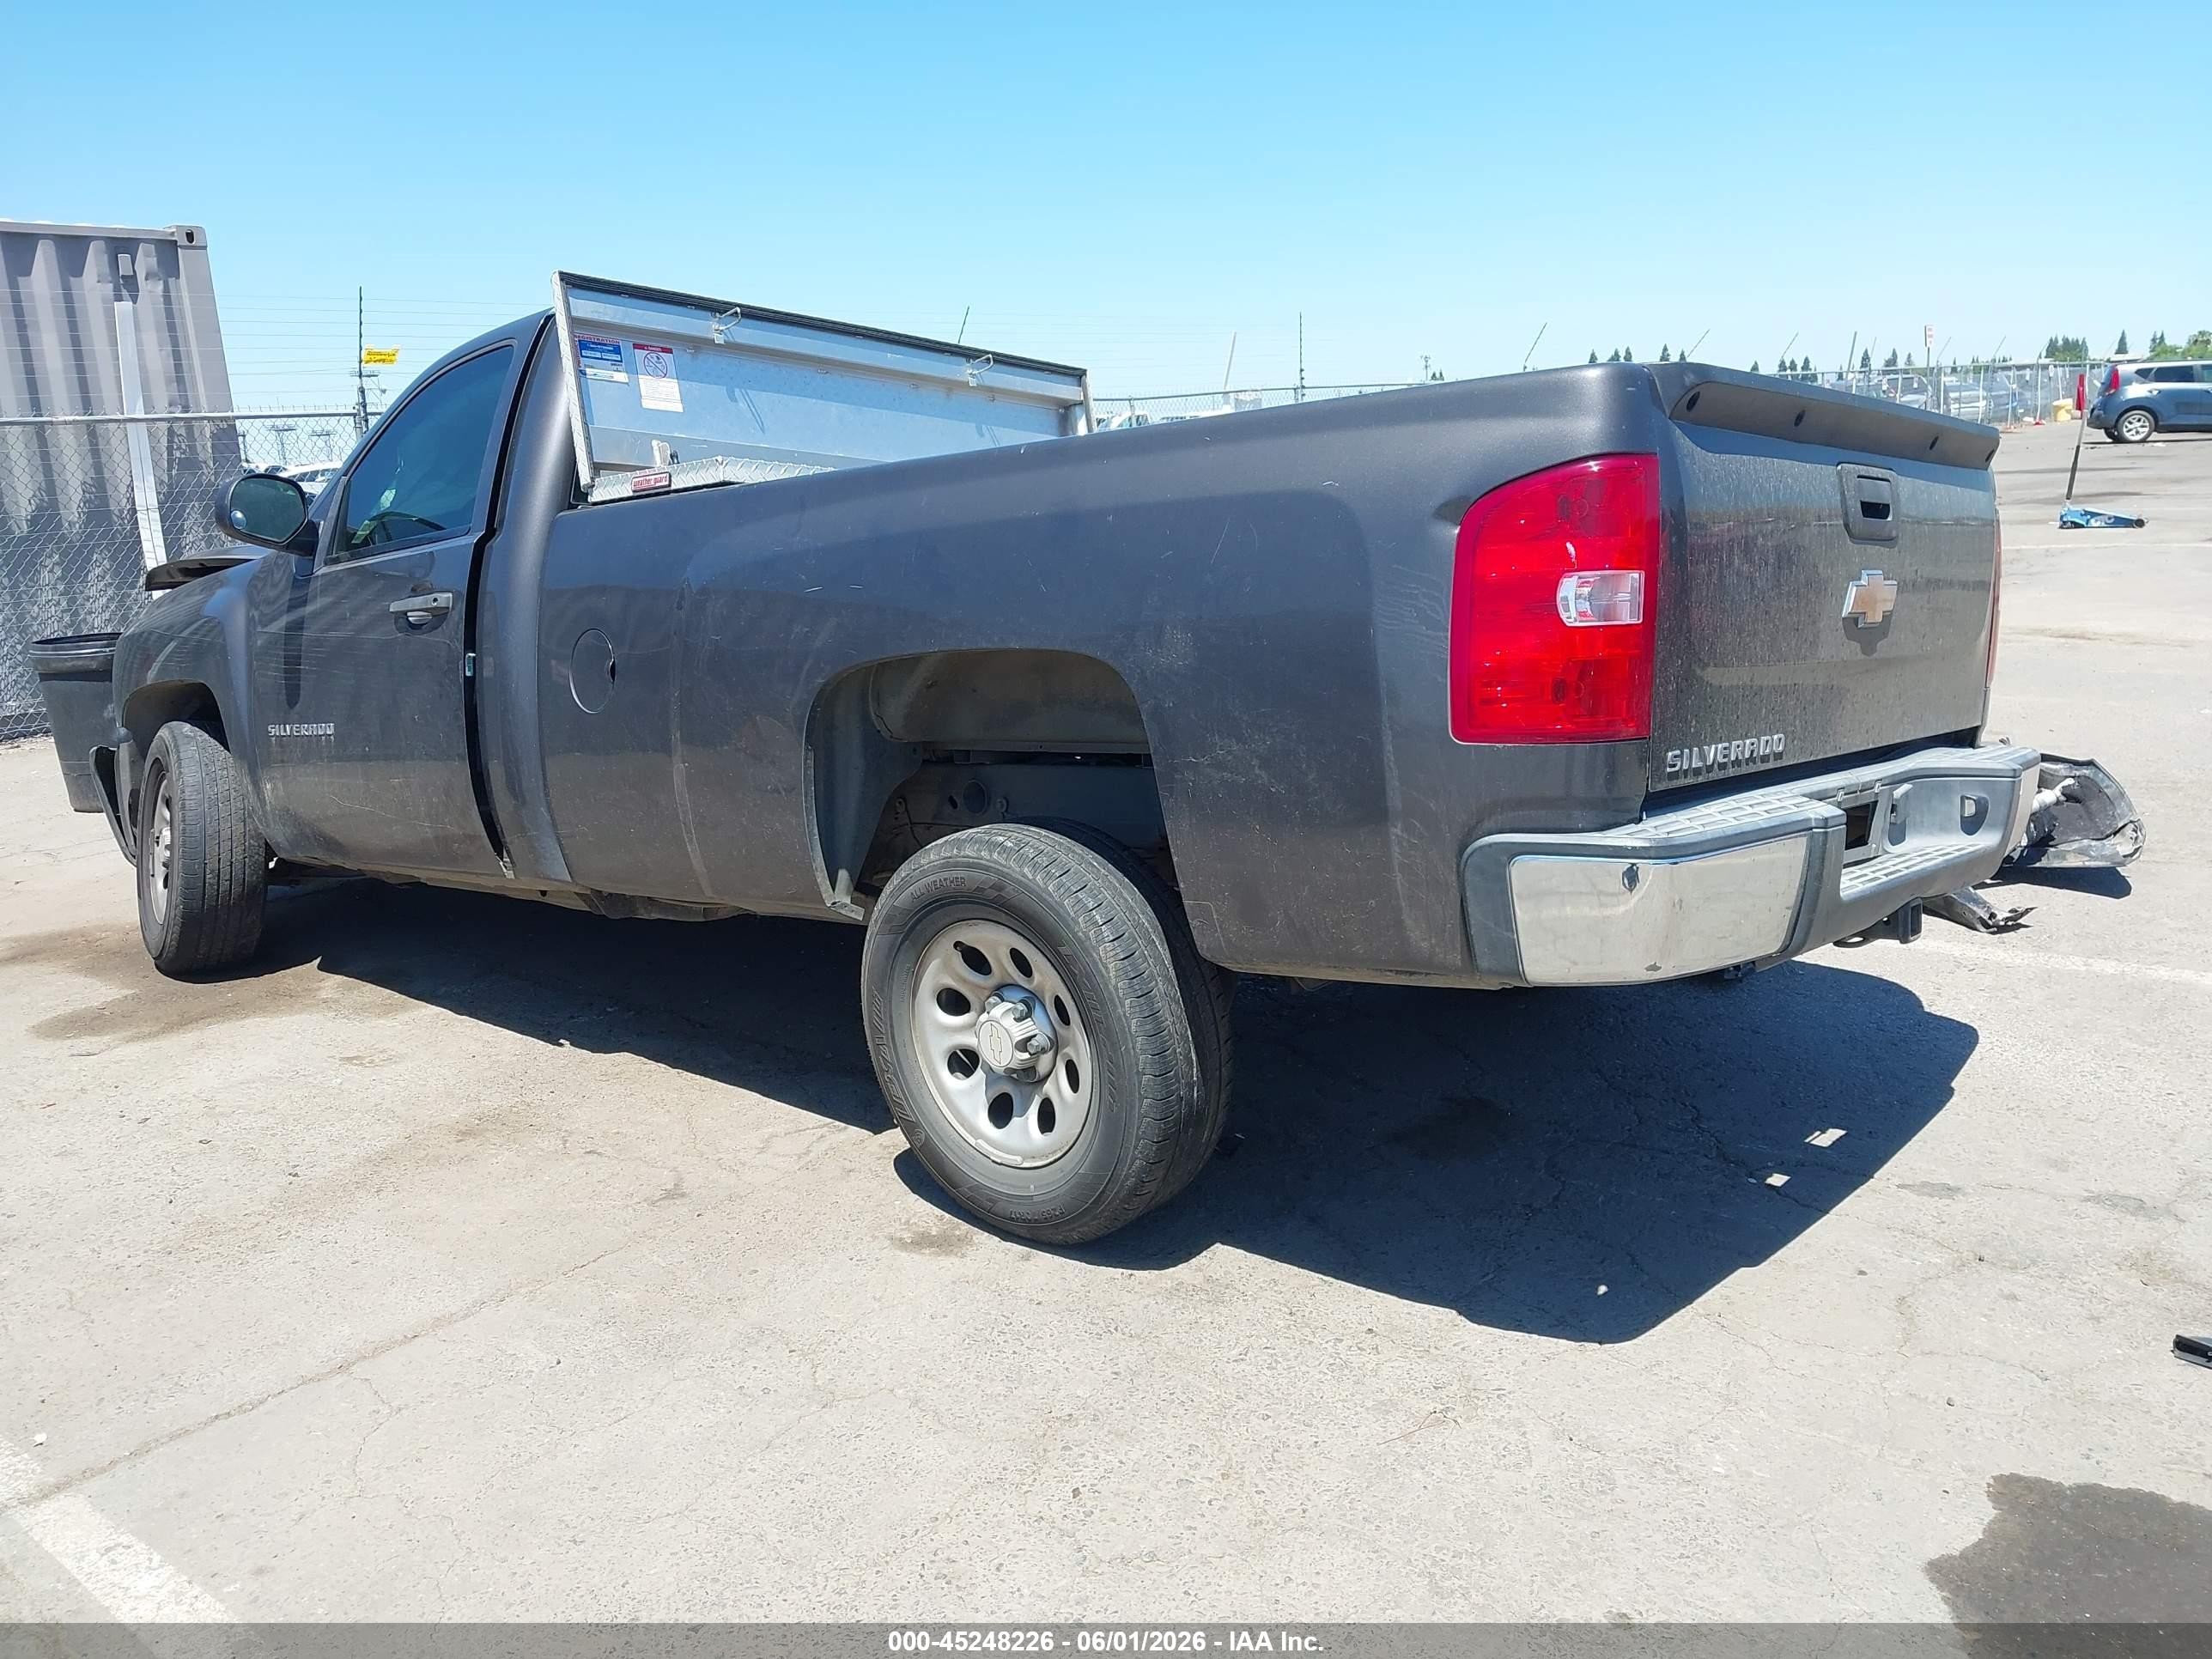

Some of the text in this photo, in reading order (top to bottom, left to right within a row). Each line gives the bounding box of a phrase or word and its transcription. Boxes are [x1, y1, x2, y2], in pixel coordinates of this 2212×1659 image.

[268, 722, 335, 736] SILVERADO
[1667, 733, 1786, 773] SILVERADO
[910, 876, 967, 902] ALL WEATHER
